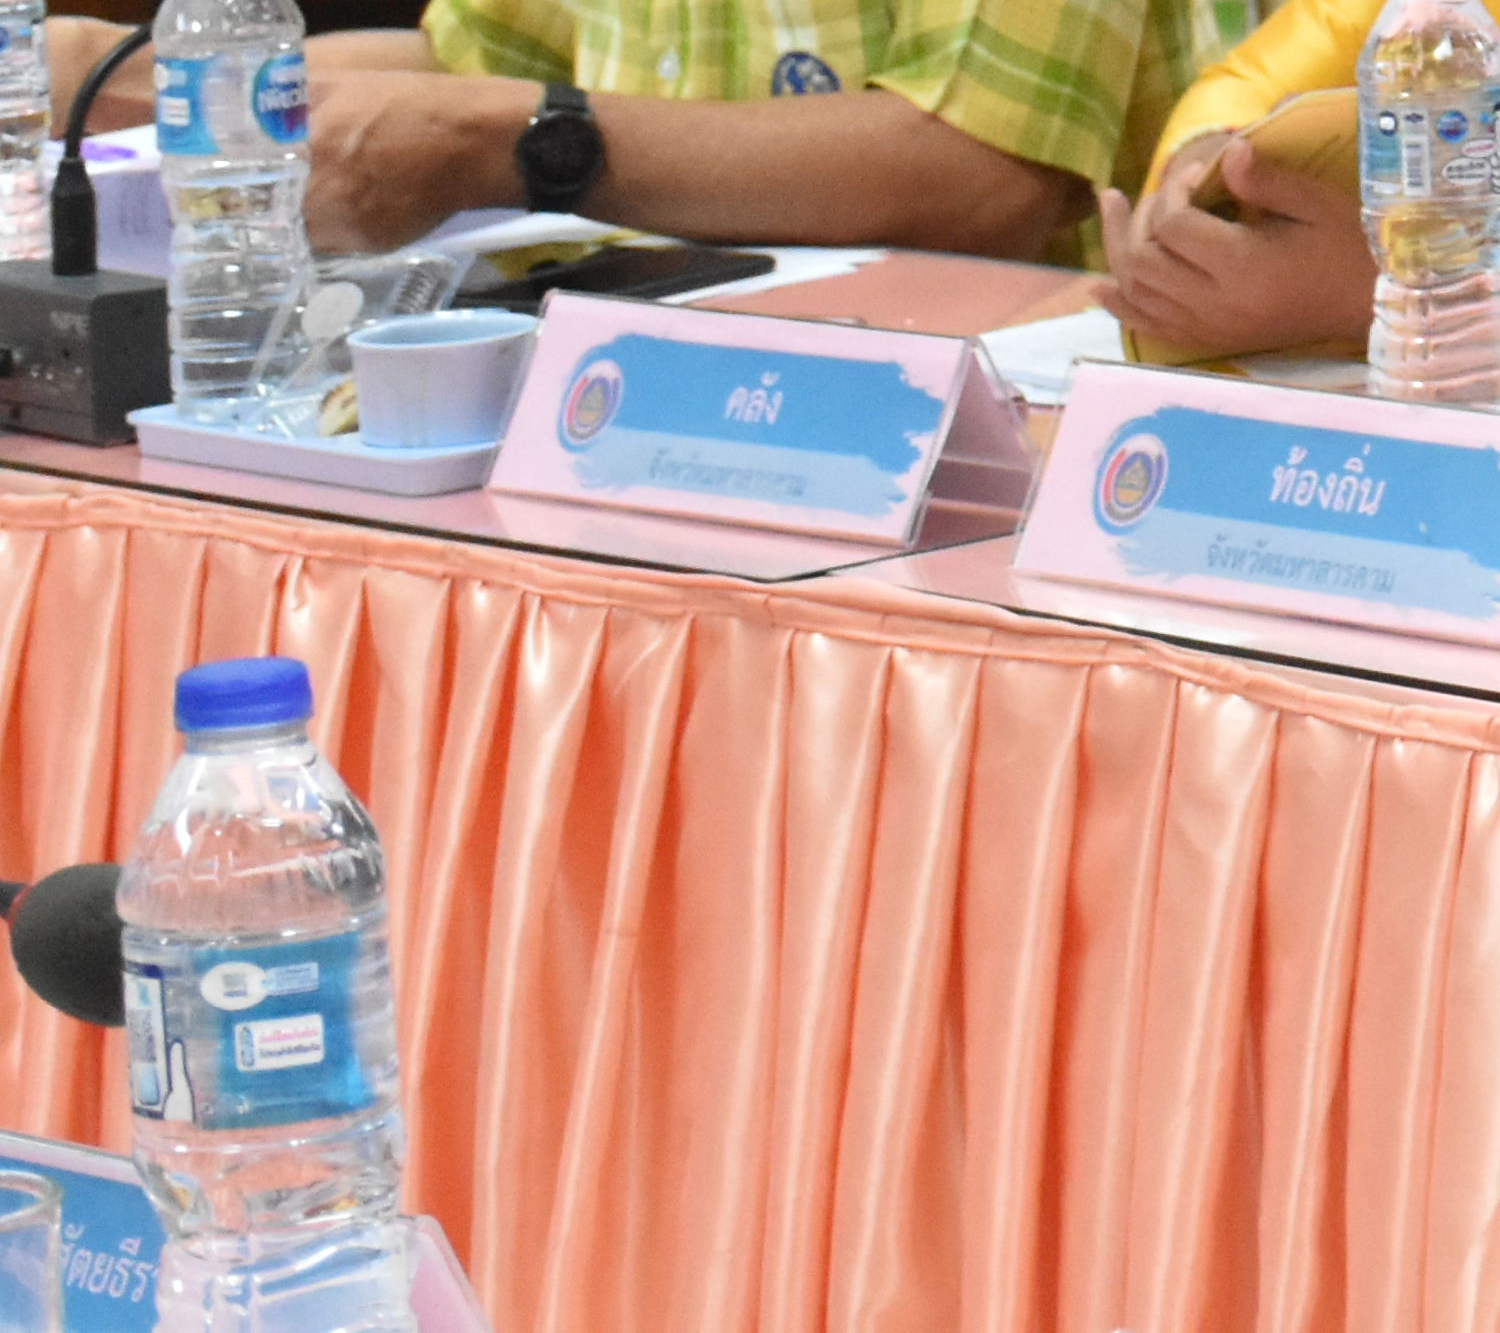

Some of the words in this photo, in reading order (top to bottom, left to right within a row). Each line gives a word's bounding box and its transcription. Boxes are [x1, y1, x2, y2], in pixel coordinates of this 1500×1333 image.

[724, 369, 785, 427] คลัง
[1268, 441, 1387, 517] ท้องถิ่น
[60, 1222, 161, 1304] ัตยธีร
